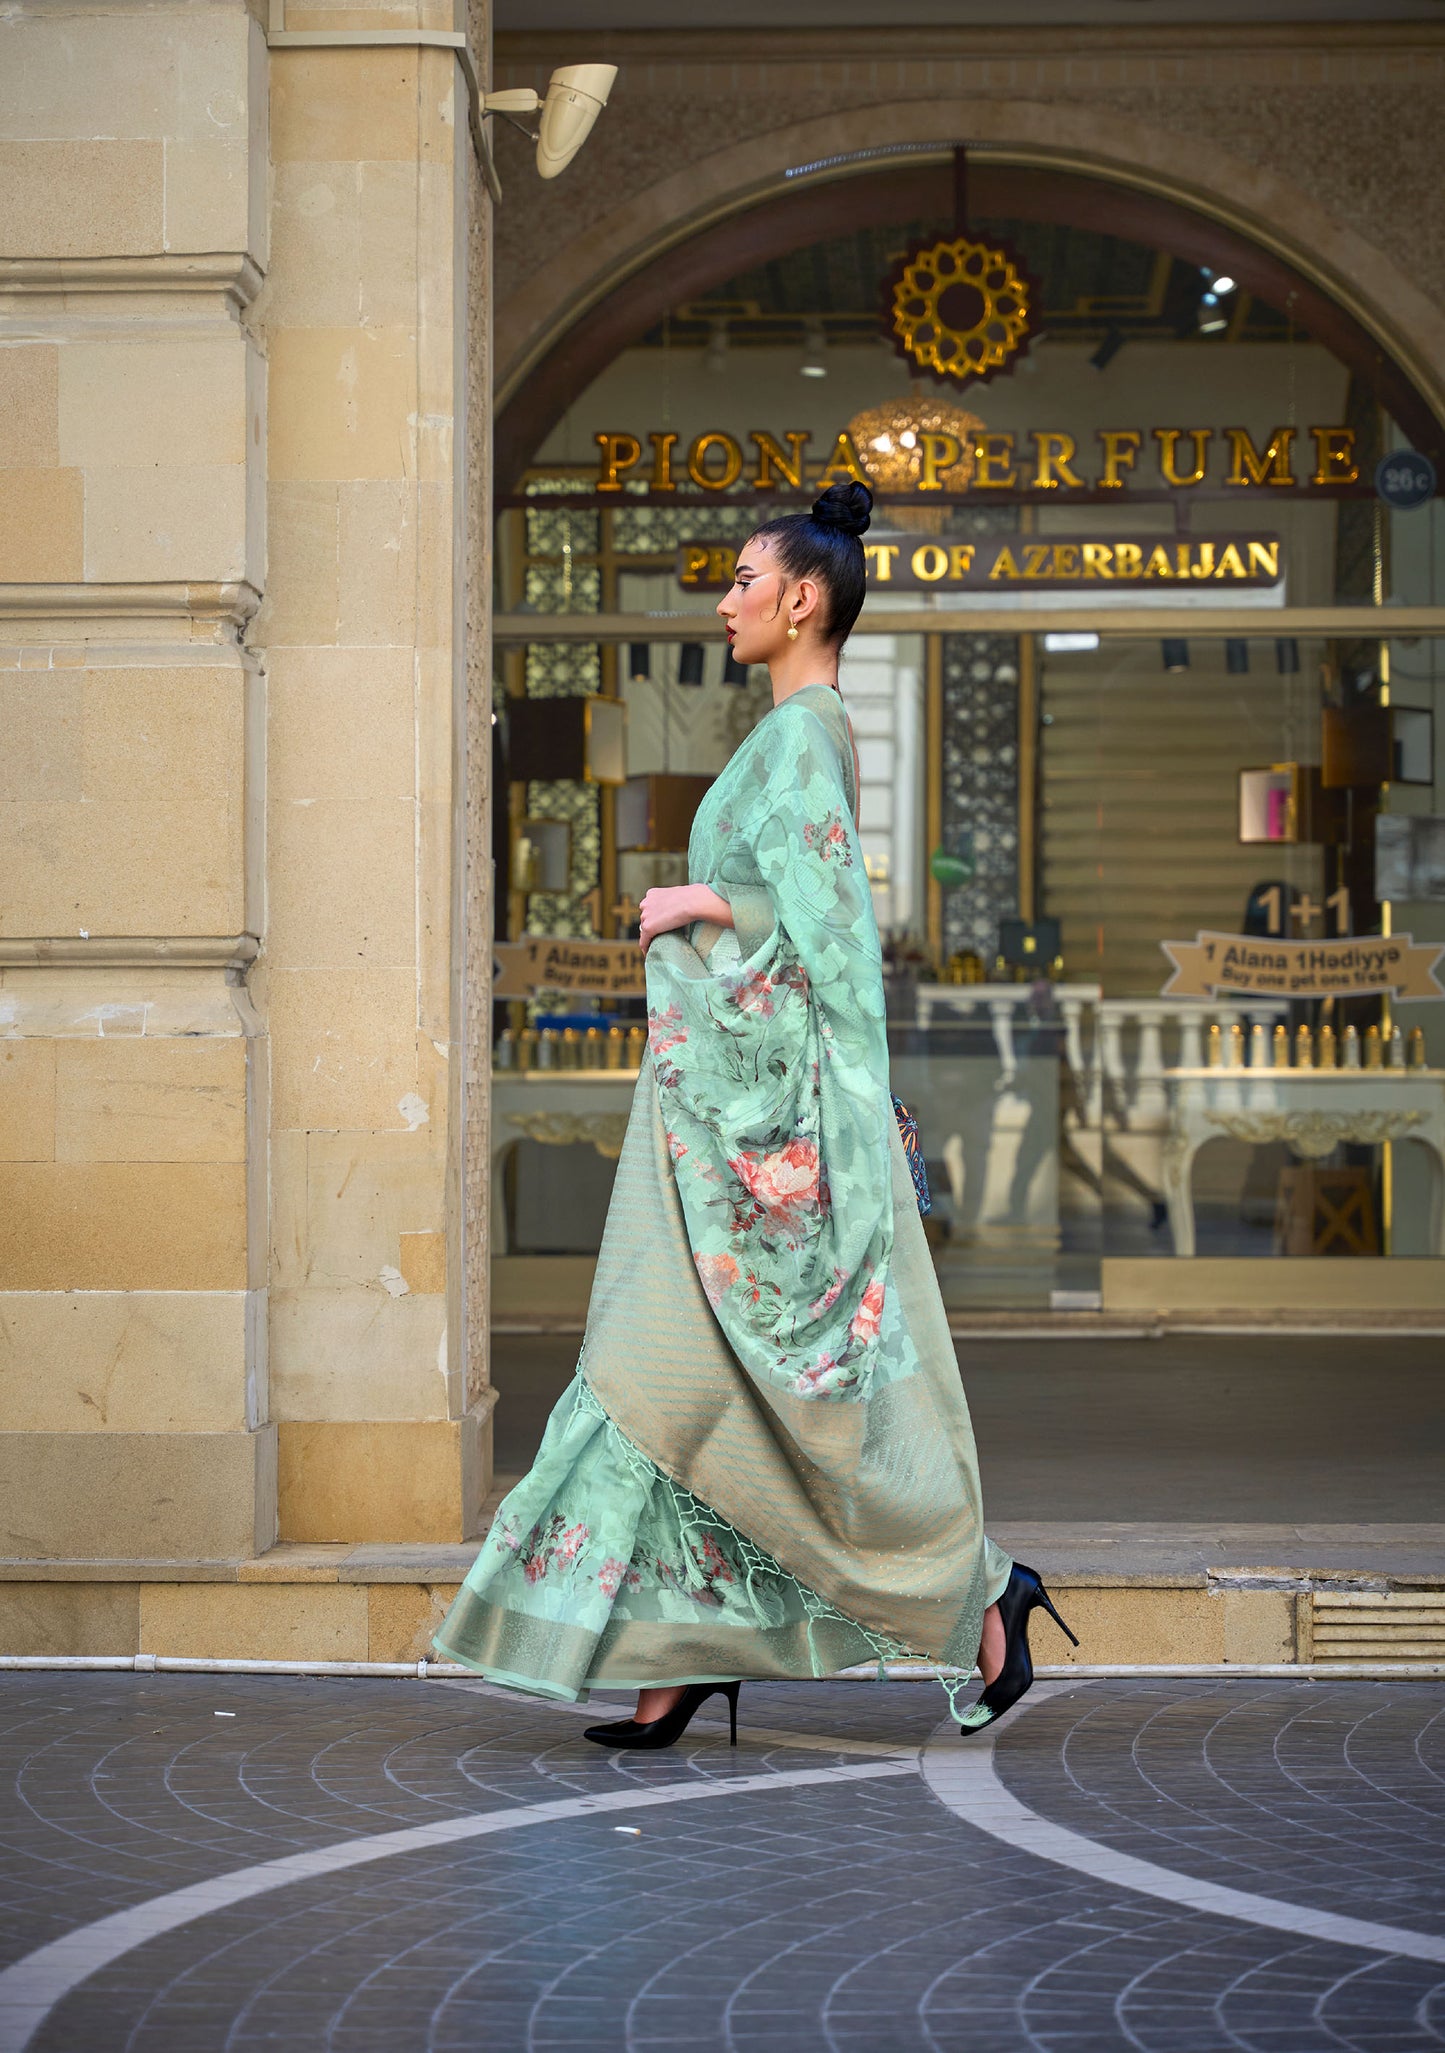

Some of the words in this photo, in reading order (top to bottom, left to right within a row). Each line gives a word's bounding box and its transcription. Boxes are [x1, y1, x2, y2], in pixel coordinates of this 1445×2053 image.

[594, 433, 872, 491] PIONA
[917, 428, 1360, 490] PERFUME
[911, 544, 976, 581] OF
[988, 541, 1281, 582] AZERBAIJAN
[581, 888, 641, 932] 1+
[1258, 886, 1350, 934] 1+1
[546, 947, 609, 969] Alana
[1224, 946, 1288, 969] Alana
[544, 965, 574, 986] Buy
[1222, 966, 1251, 986] Buy
[1256, 973, 1286, 986] one
[1290, 973, 1316, 989] get
[1321, 973, 1350, 986] one
[1354, 969, 1388, 984] free
